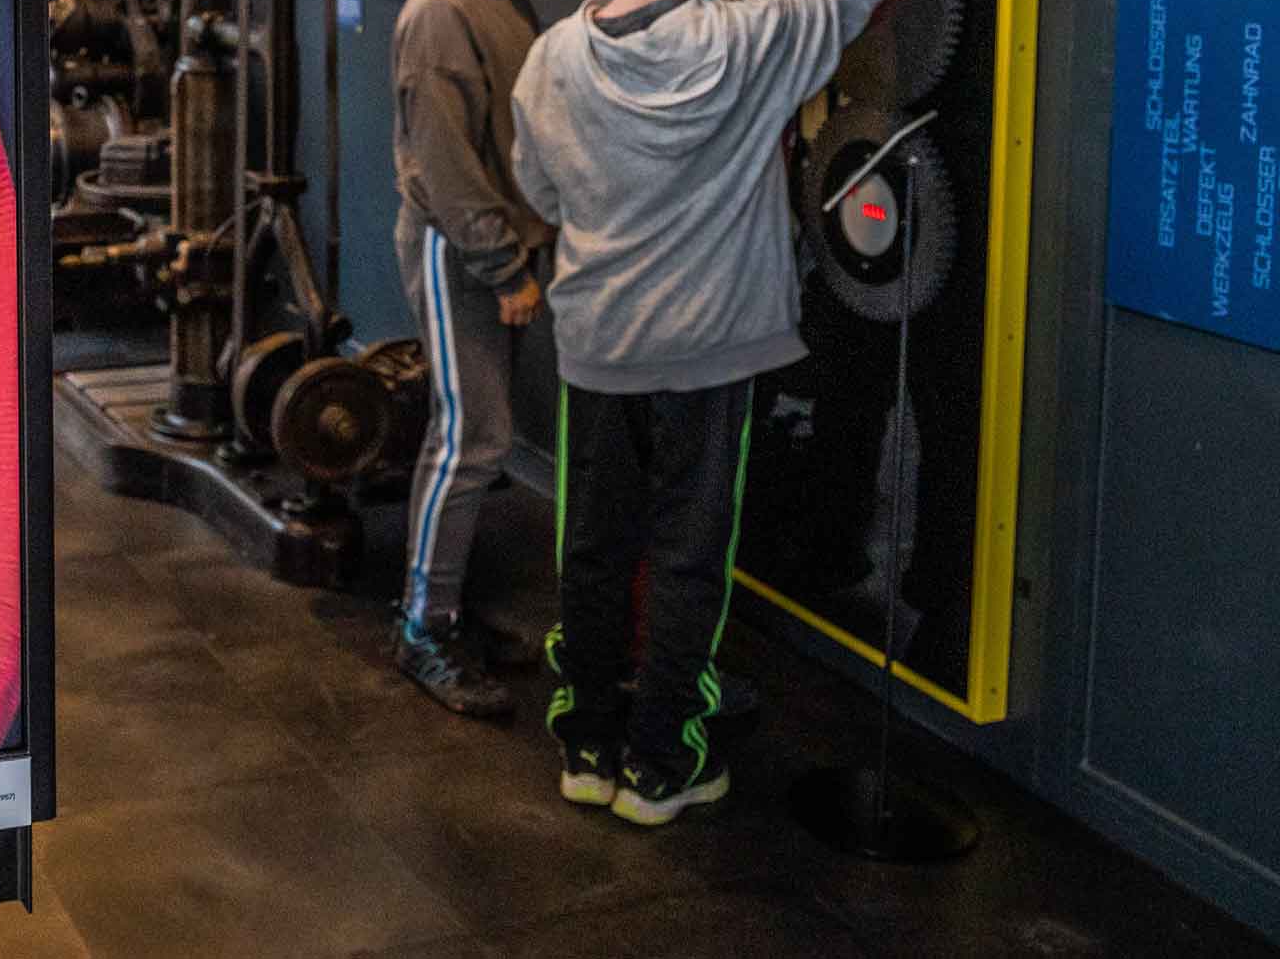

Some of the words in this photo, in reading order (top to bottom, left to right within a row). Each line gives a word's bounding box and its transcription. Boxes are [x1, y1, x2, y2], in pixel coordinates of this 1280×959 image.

[1182, 33, 1202, 153] WARTUNG
[1239, 23, 1262, 145] ZAHNRAD
[1196, 142, 1216, 236] DEFEKT
[1212, 183, 1234, 317] WERKZEUG
